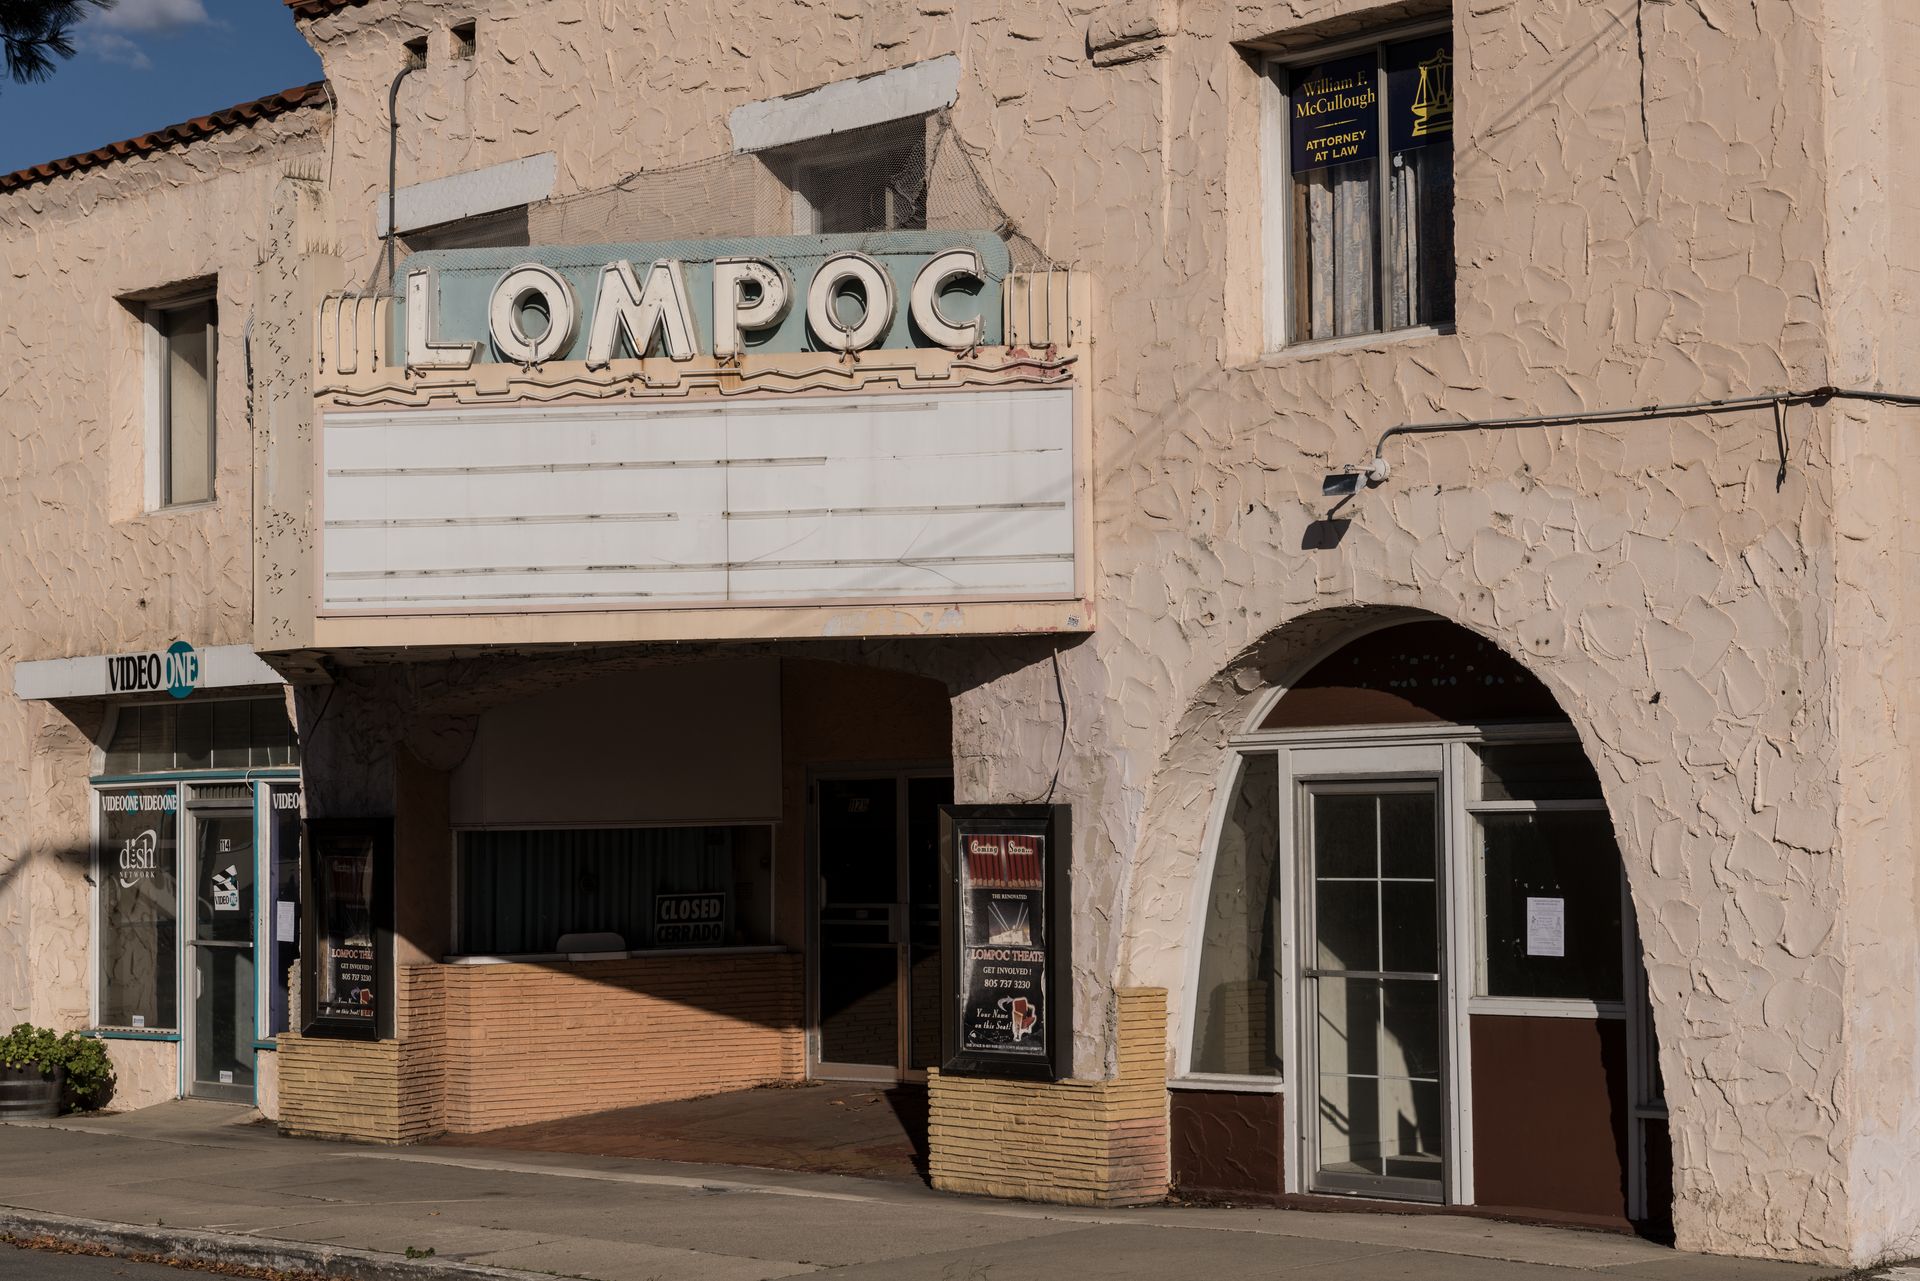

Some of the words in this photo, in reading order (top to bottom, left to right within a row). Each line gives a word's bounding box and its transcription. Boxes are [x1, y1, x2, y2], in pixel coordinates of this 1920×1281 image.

[1303, 77, 1353, 97] William
[1357, 71, 1368, 87] F.
[1296, 88, 1375, 118] McCullough
[1306, 130, 1366, 151] ATTORNEY
[1315, 150, 1328, 162] AT
[1333, 145, 1358, 158] LAW
[405, 247, 987, 371] LOMPOC
[108, 653, 161, 692] VIDEO
[165, 651, 198, 689] ONE
[119, 838, 156, 869] dish
[971, 840, 998, 856] Coming
[661, 898, 720, 920] CLOSED
[657, 923, 721, 941] CERRADO
[331, 948, 358, 958] LOMPOC
[971, 948, 1010, 960] LOMPOC
[983, 966, 995, 974] GET
[996, 967, 1028, 975] INVOLVED
[984, 979, 998, 988] 805
[999, 979, 1012, 988] 737
[1014, 980, 1031, 989] 3230
[976, 1008, 990, 1018] Your
[992, 1009, 1008, 1019] Name
[983, 1020, 994, 1029] this
[996, 1020, 1012, 1030] Seat!
